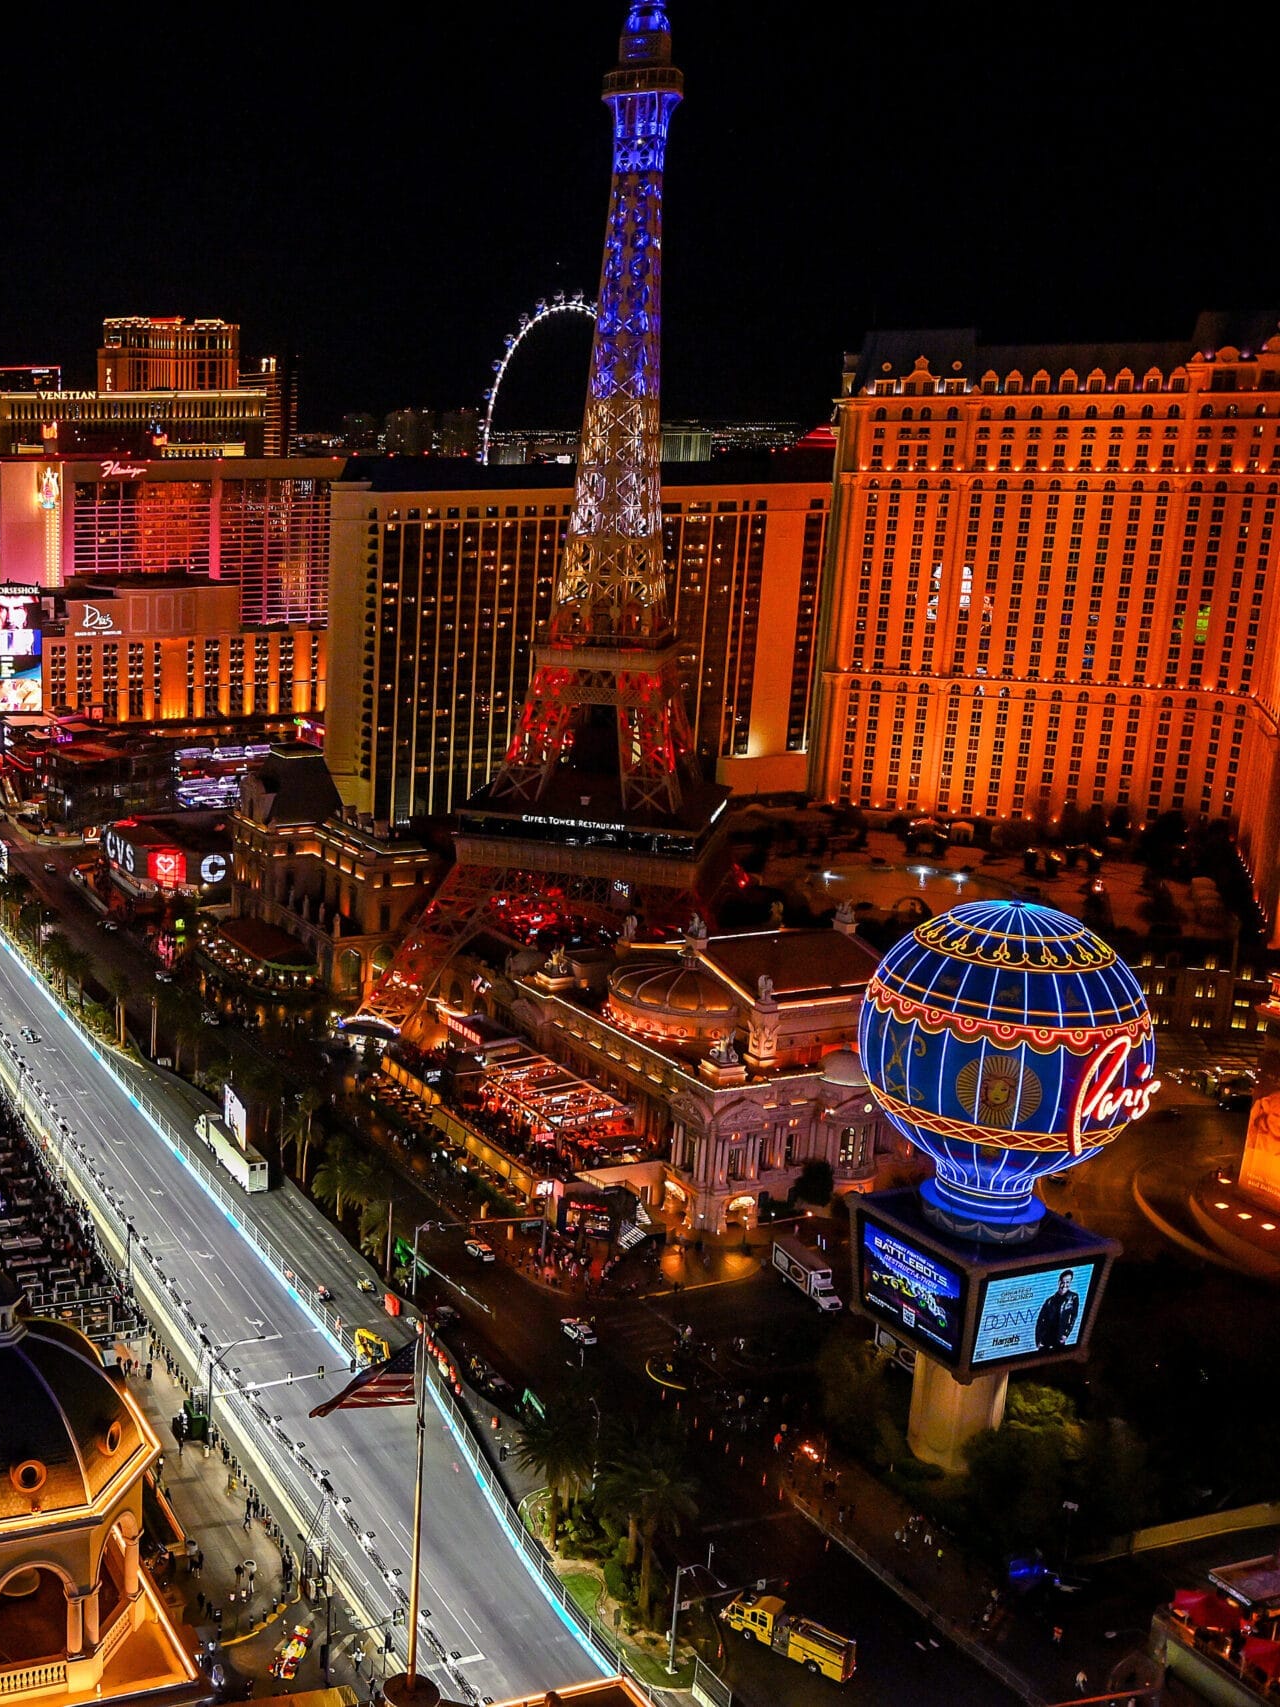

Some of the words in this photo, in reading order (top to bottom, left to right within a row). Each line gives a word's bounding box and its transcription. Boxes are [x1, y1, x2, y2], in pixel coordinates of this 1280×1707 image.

[39, 391, 96, 400] VENETIAN
[522, 814, 548, 824] EIFFEL
[548, 816, 575, 827] TOWER
[578, 819, 625, 831] RESTAURANT
[106, 831, 134, 872] CVS
[447, 1017, 463, 1034] BEER
[1073, 1035, 1161, 1157] Paris
[874, 1236, 948, 1287] BATTLEBOTS
[983, 1306, 1041, 1331] DONNY
